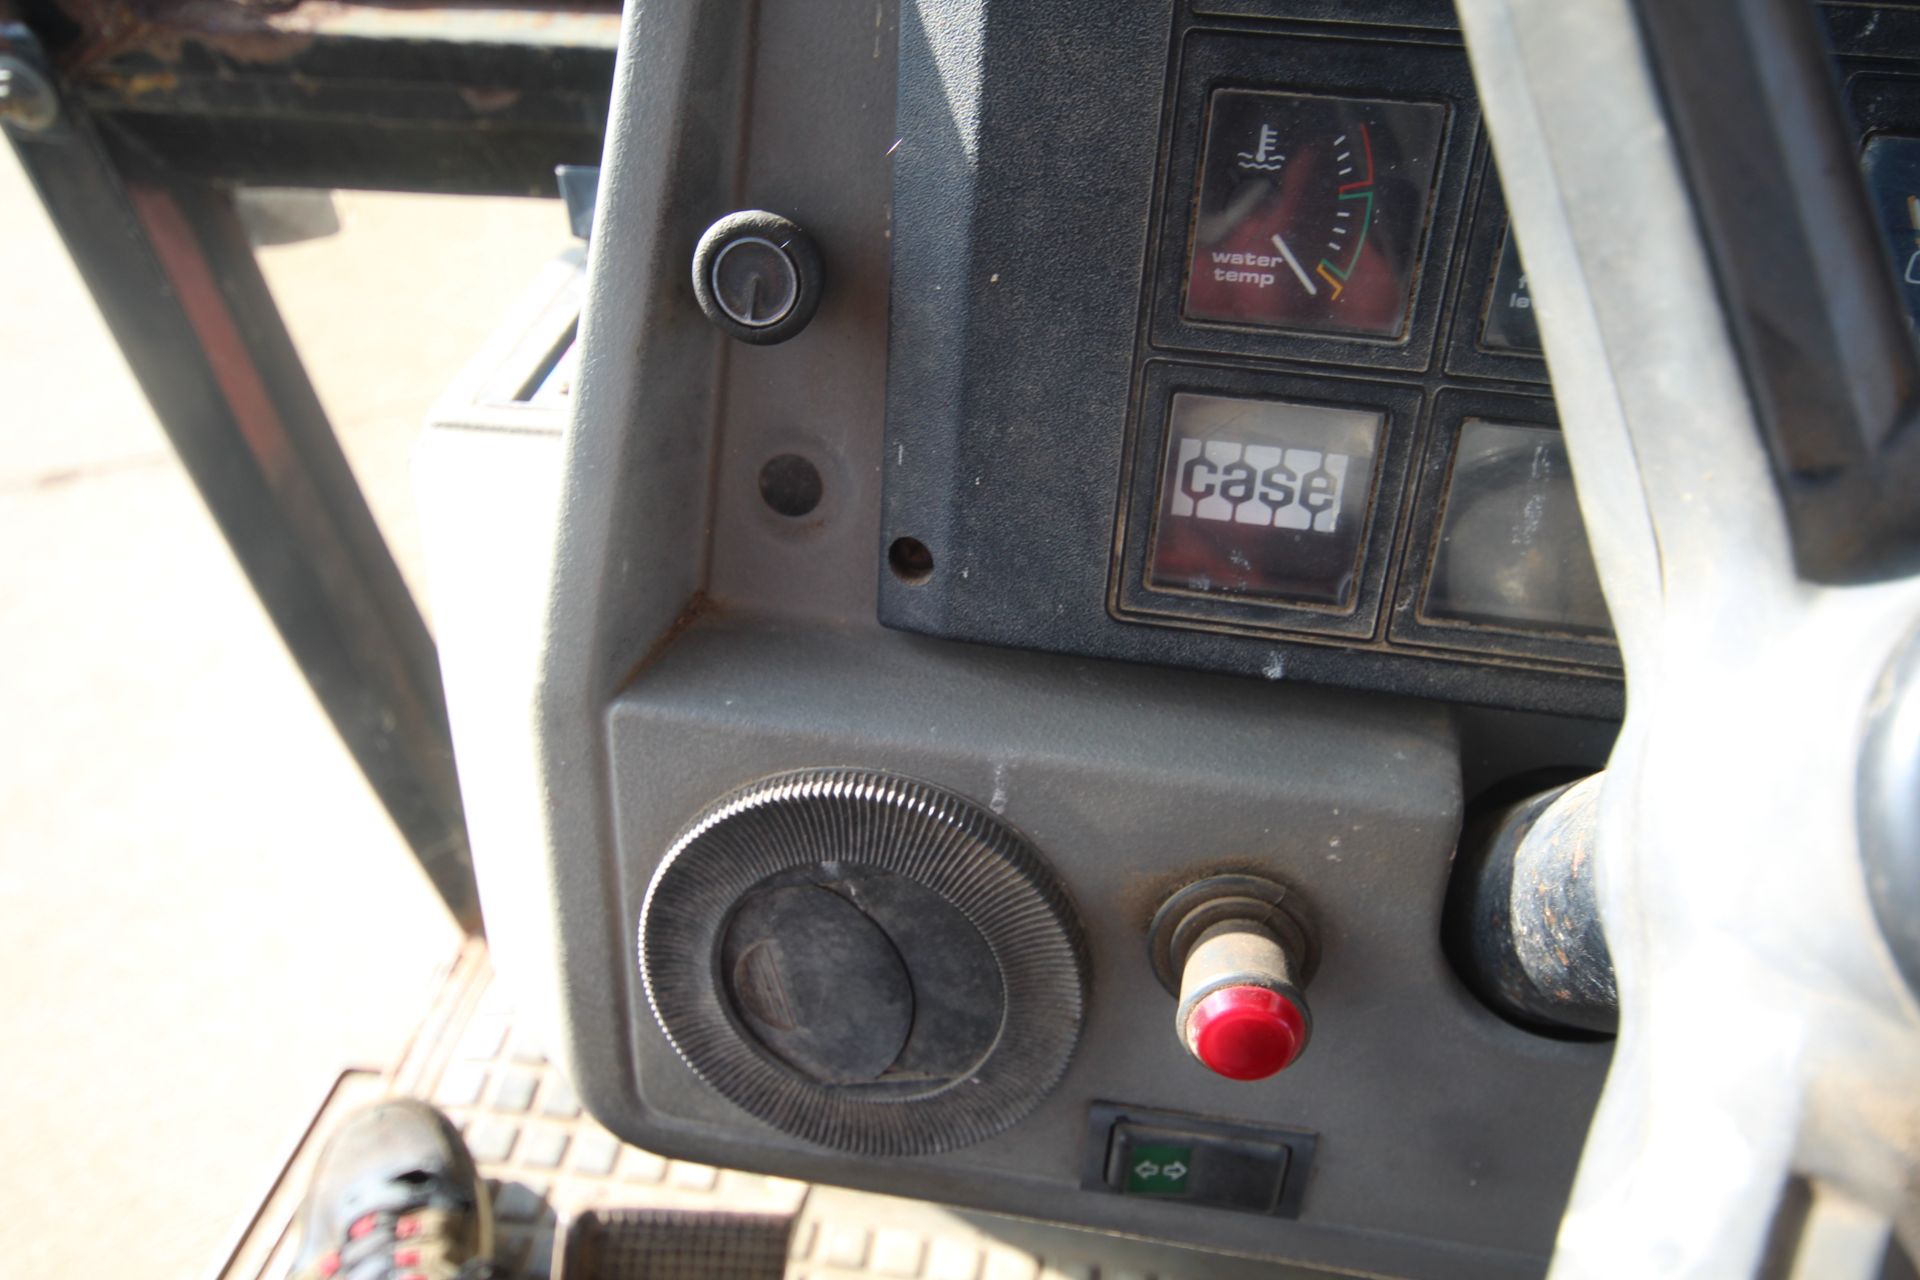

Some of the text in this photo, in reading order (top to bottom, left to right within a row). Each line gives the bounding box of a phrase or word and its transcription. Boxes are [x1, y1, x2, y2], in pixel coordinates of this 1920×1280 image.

[1212, 251, 1283, 268] water
[1214, 268, 1275, 288] temp
[1179, 450, 1339, 516] case
